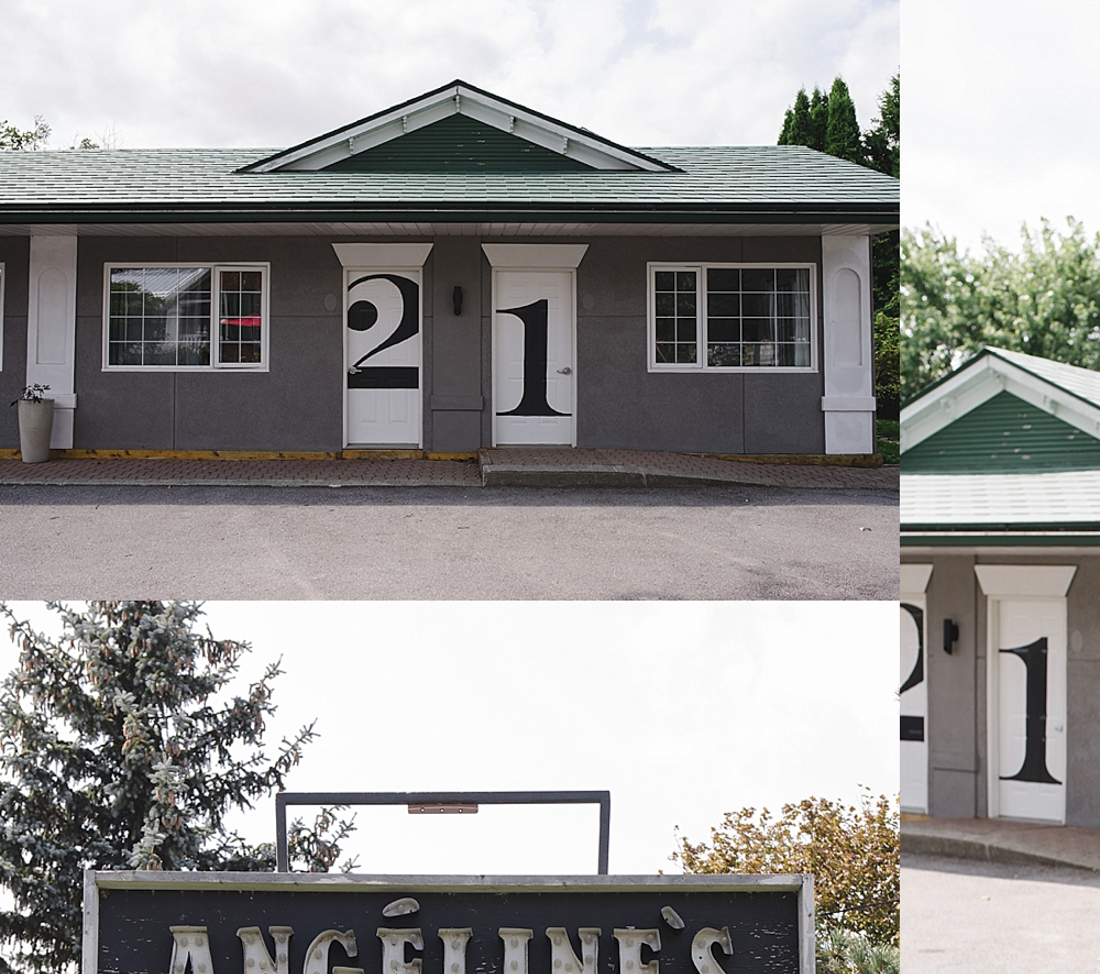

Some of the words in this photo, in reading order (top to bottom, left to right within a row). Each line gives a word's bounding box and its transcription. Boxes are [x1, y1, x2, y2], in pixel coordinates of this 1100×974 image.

[347, 274, 419, 389] 2
[495, 299, 573, 416] 1
[999, 636, 1062, 785] 1
